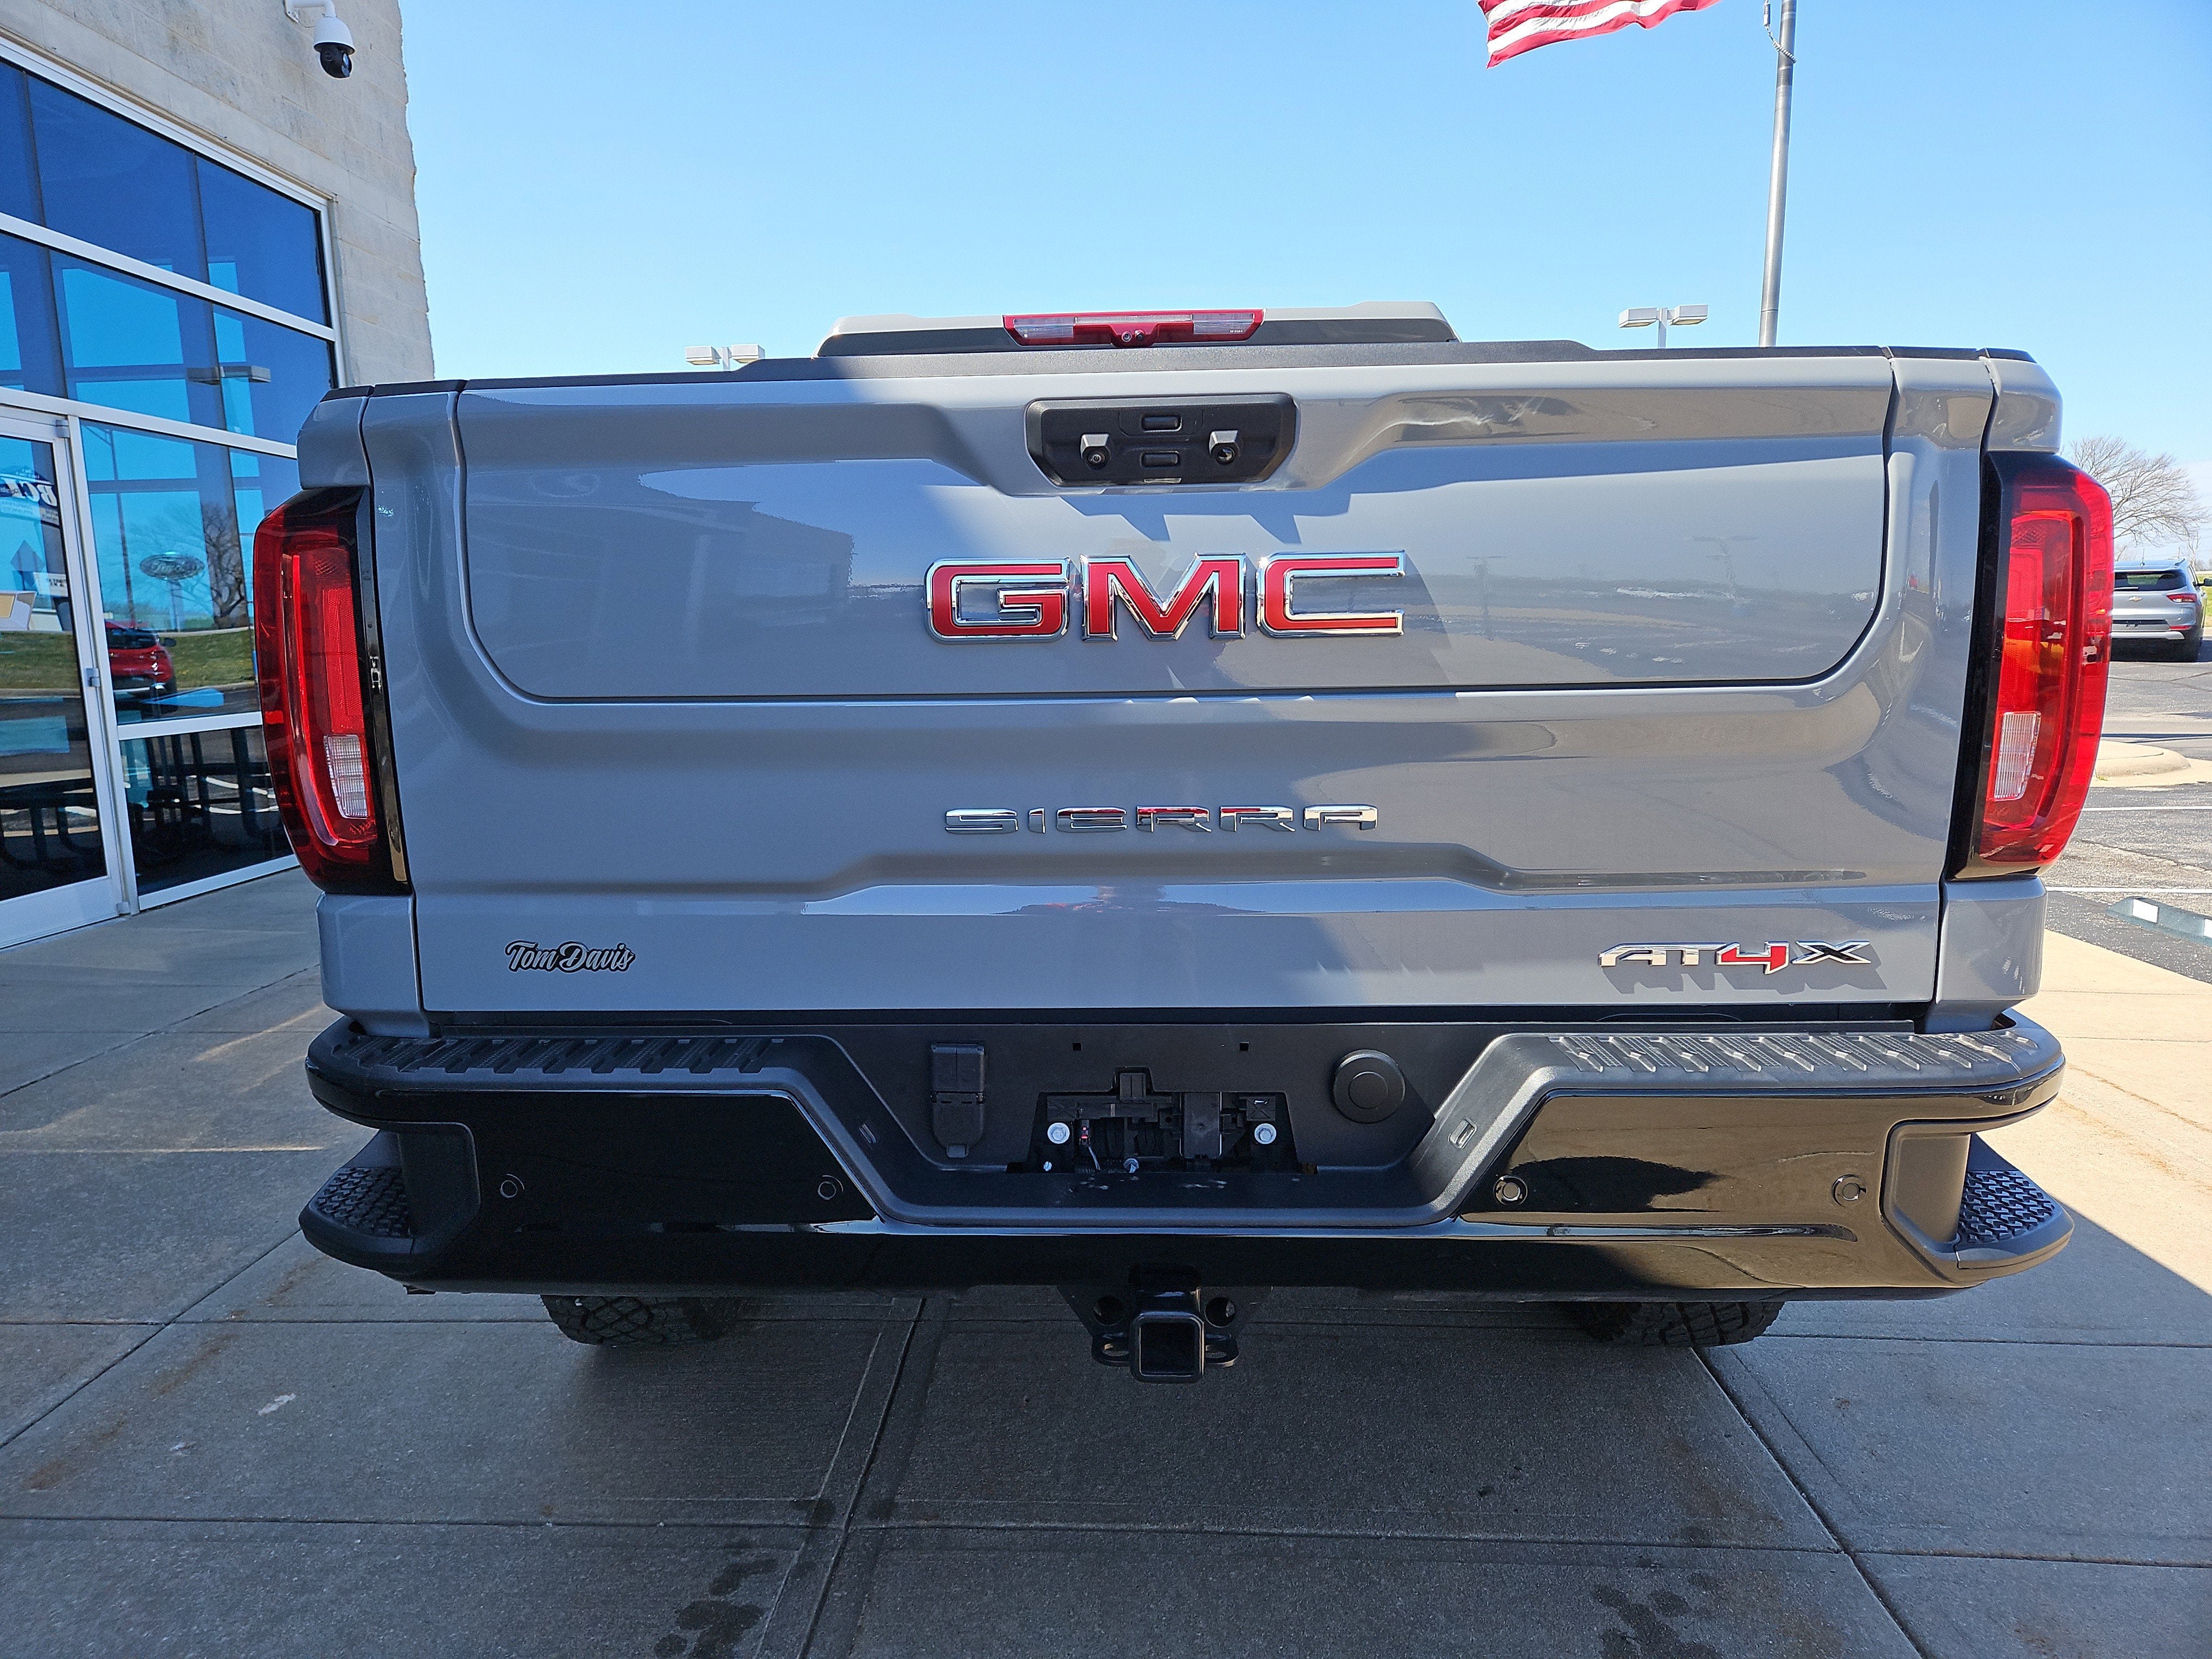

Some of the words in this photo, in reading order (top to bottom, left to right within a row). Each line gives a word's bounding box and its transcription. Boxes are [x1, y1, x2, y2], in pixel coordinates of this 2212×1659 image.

[925, 550, 1405, 642] GMC
[945, 805, 1379, 833] SIERRA
[1599, 941, 1872, 975] AT4X
